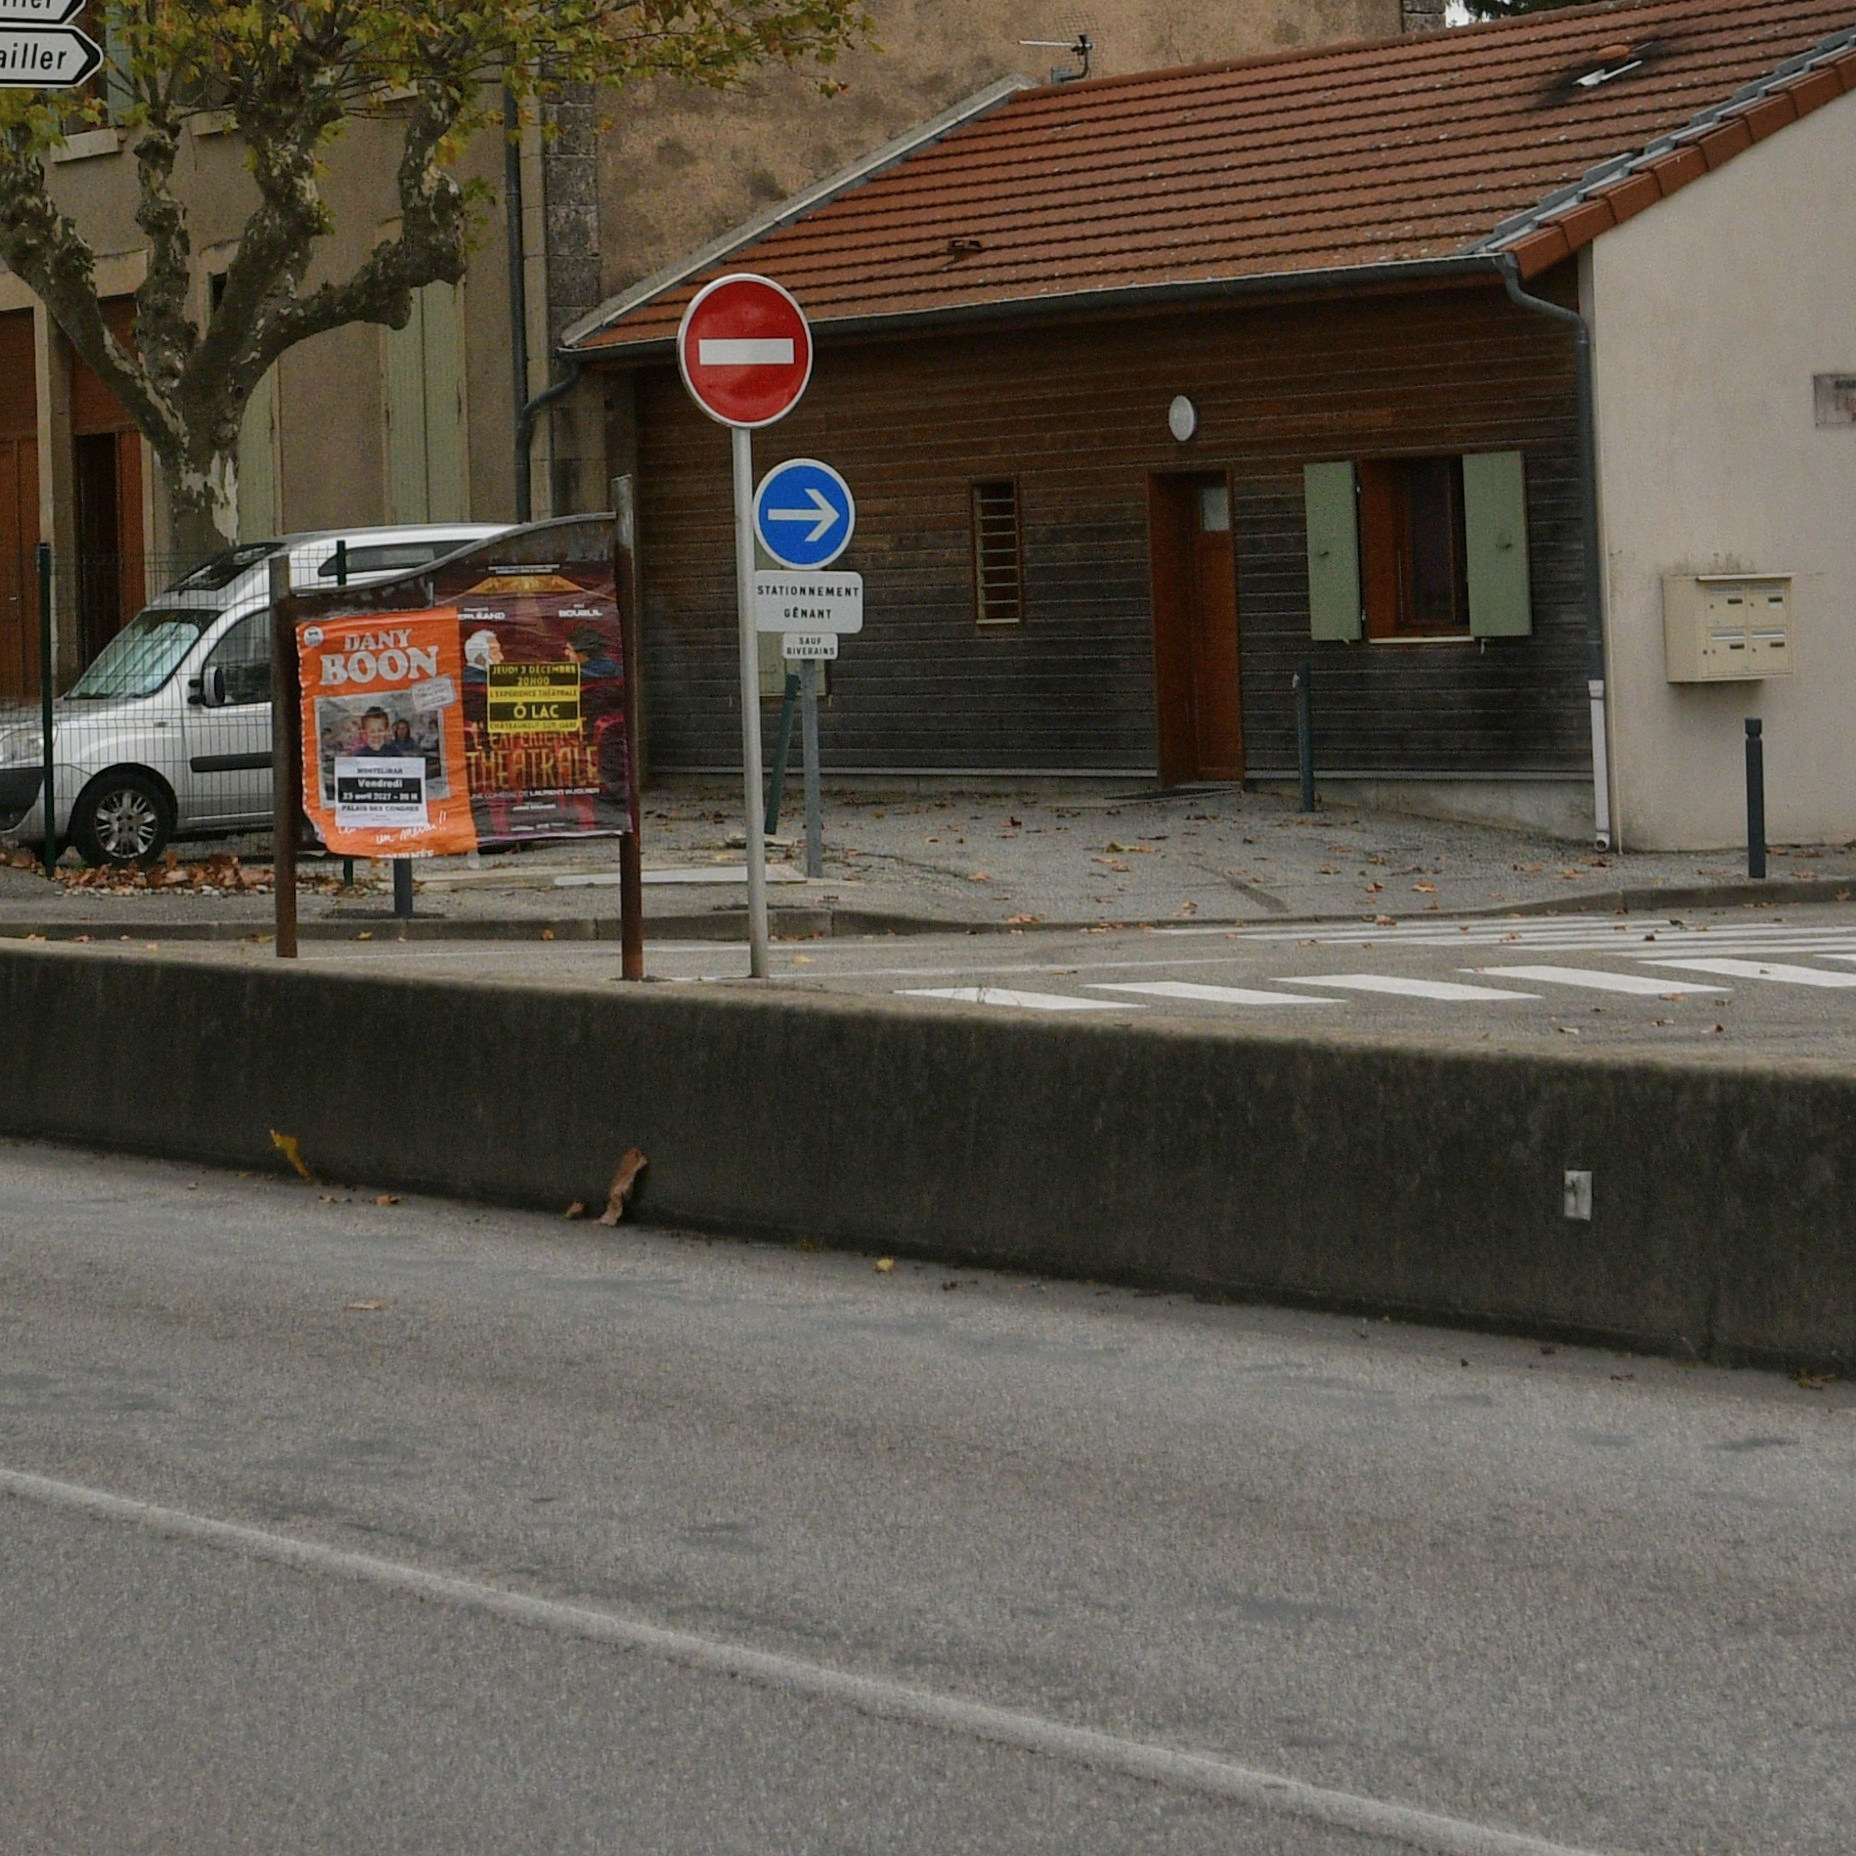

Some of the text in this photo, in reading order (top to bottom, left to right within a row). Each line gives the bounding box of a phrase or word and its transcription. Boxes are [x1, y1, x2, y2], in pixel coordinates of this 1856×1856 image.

[757, 585, 859, 597] STATIONNEMENT
[784, 606, 832, 619] GÊNANT
[344, 628, 413, 652] DANY
[799, 637, 821, 645] SAUF
[786, 647, 835, 655] RIVERAINS
[319, 645, 439, 686] BOON
[517, 676, 550, 687] 20H00
[531, 704, 559, 719] LAC
[358, 778, 403, 788] Vendredi
